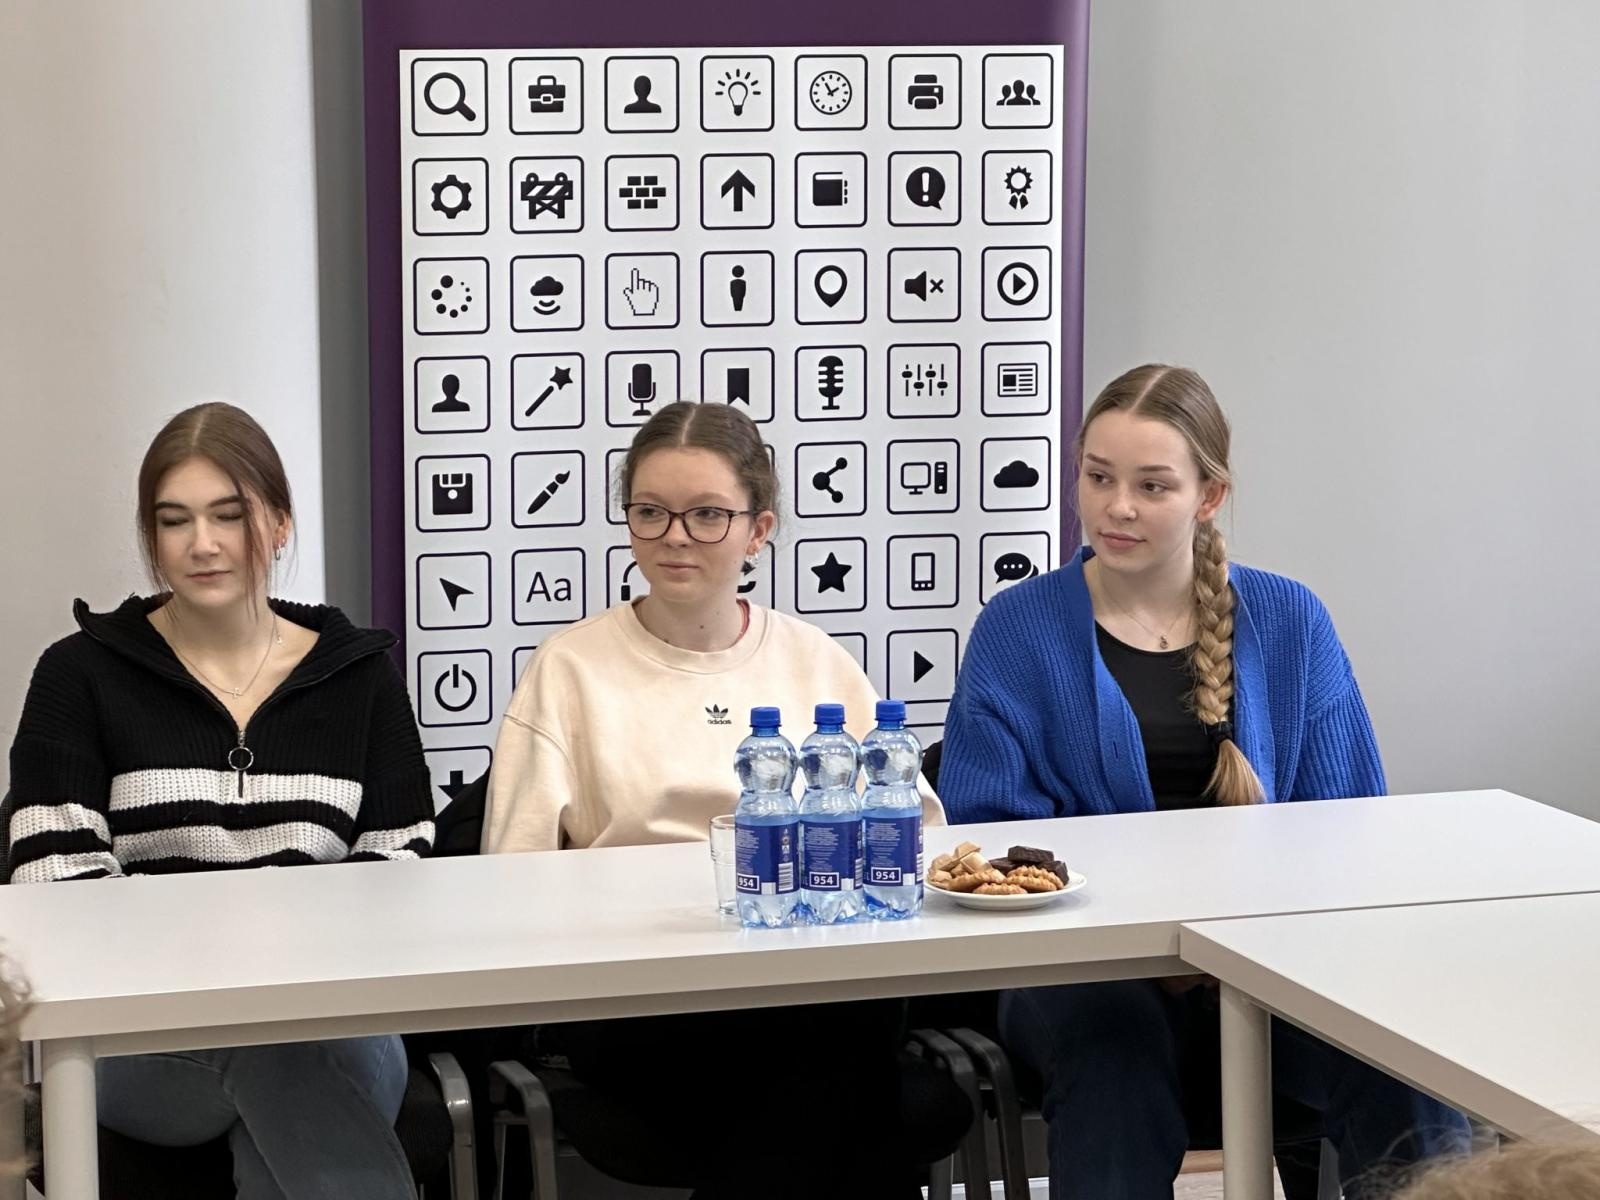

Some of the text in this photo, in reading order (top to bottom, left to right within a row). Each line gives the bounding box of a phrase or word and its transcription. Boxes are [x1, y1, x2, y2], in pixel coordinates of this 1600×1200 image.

[526, 571, 571, 603] Aa
[875, 871, 896, 880] 954
[738, 877, 754, 887] 954
[813, 876, 833, 885] 954
